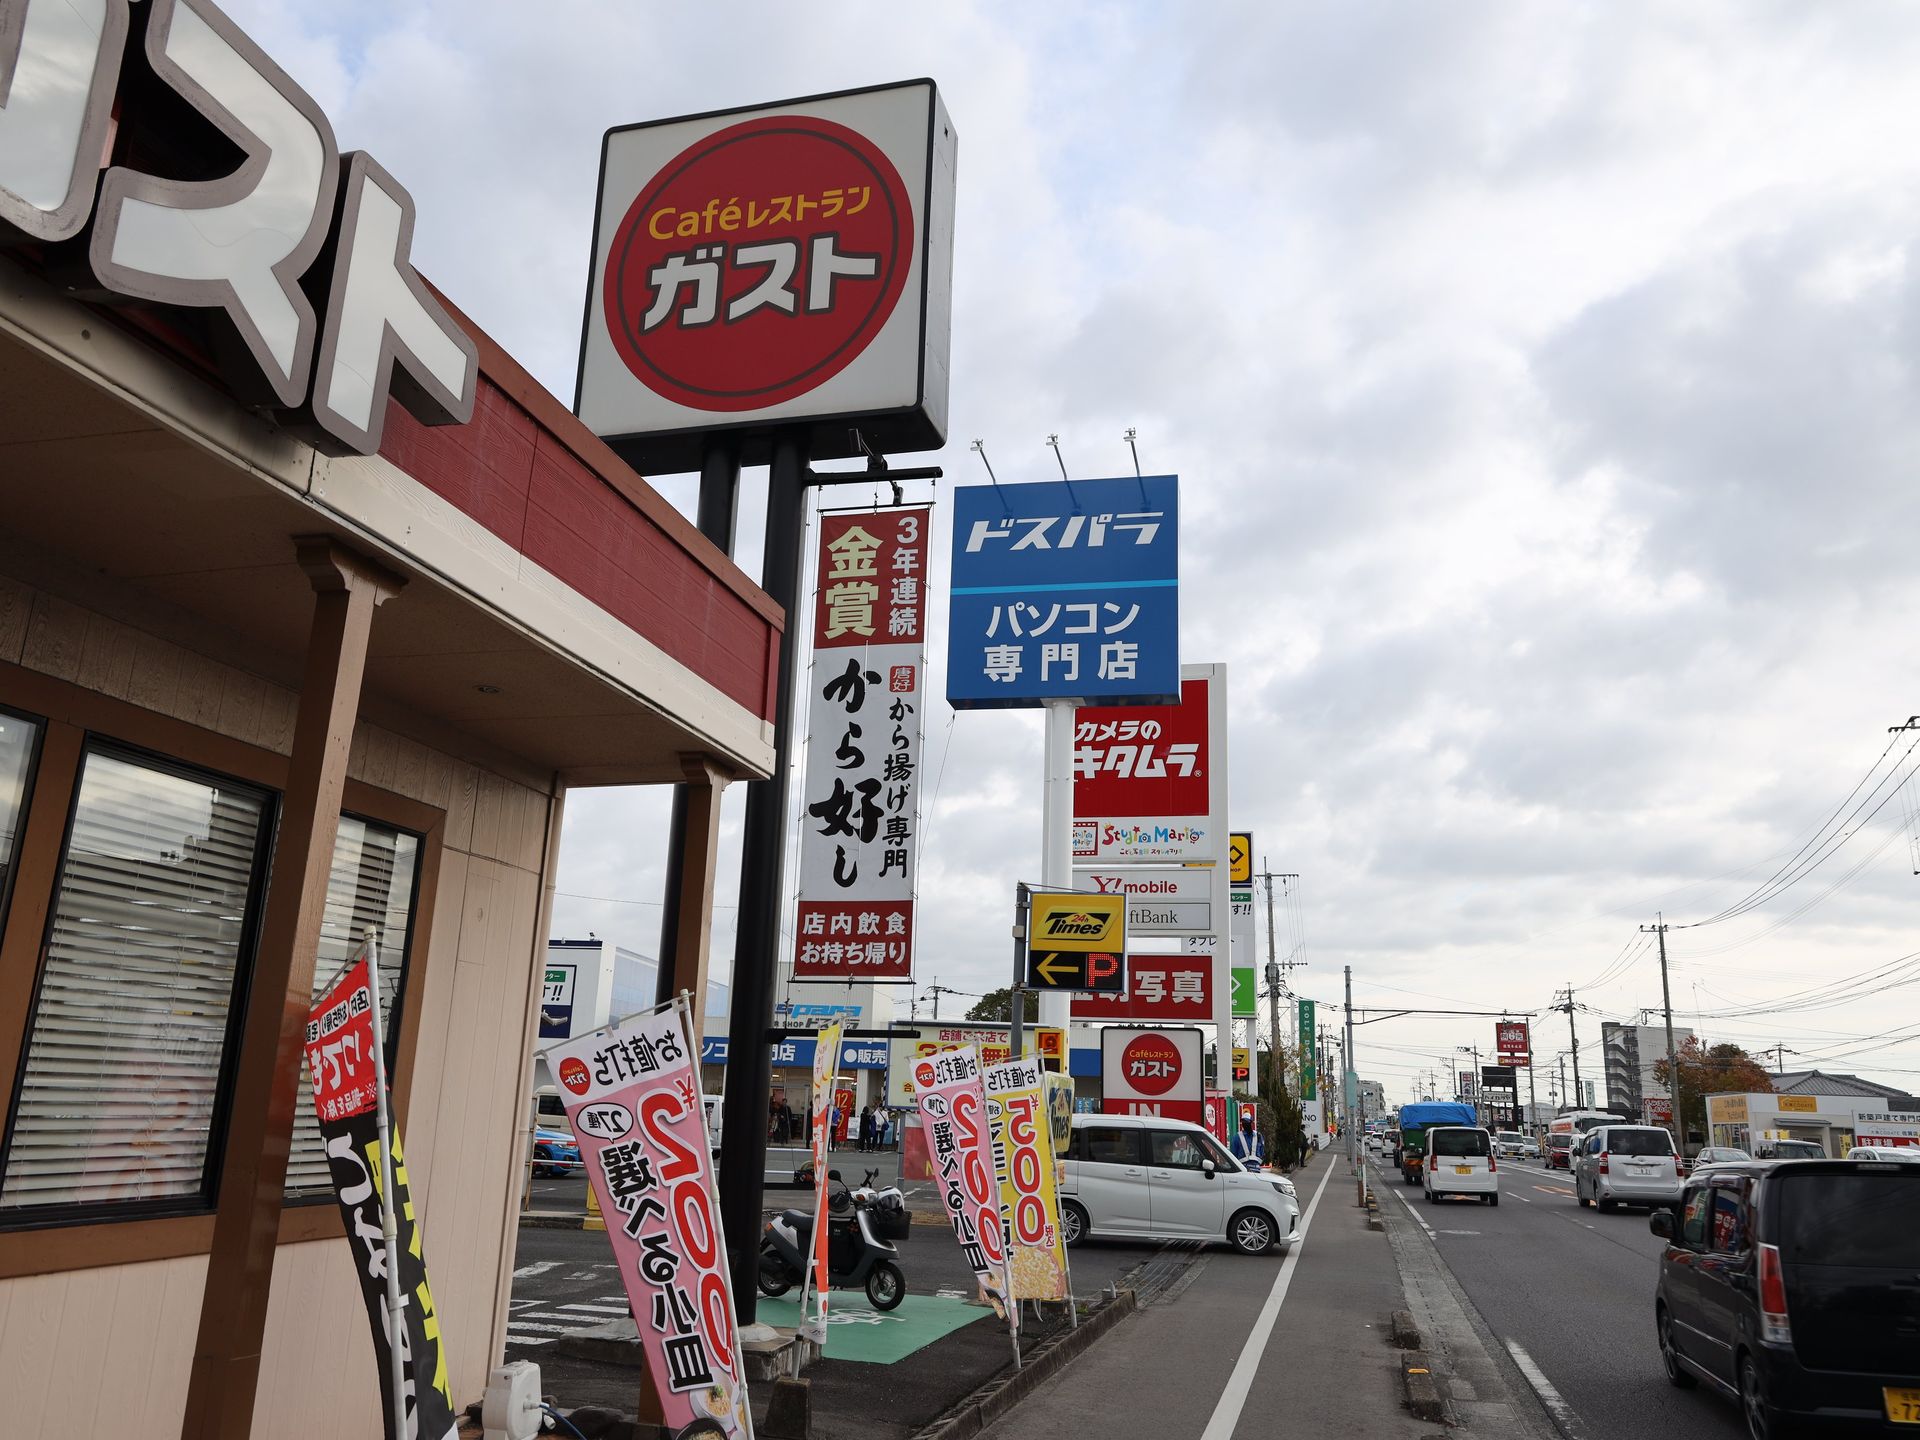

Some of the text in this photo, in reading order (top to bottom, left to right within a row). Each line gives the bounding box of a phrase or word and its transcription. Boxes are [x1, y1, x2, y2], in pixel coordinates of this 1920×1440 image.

[641, 233, 880, 333] ガスト
[965, 511, 1164, 552] ドスパラ
[824, 525, 884, 640] 金賞
[887, 516, 919, 637] 3年連続
[985, 601, 1141, 638] パソコン
[983, 640, 1139, 683] 専門店
[1074, 720, 1162, 742] カメラの
[808, 658, 885, 888] から好し
[879, 697, 916, 879] から揚げ専門
[802, 911, 906, 935] 店内飲食
[1046, 913, 1107, 934] Times
[1128, 909, 1178, 924] ftBank
[799, 940, 906, 965] お持ち帰り
[1088, 953, 1118, 987] P
[1130, 1060, 1176, 1078] ガスト
[1128, 1103, 1161, 1116] IN
